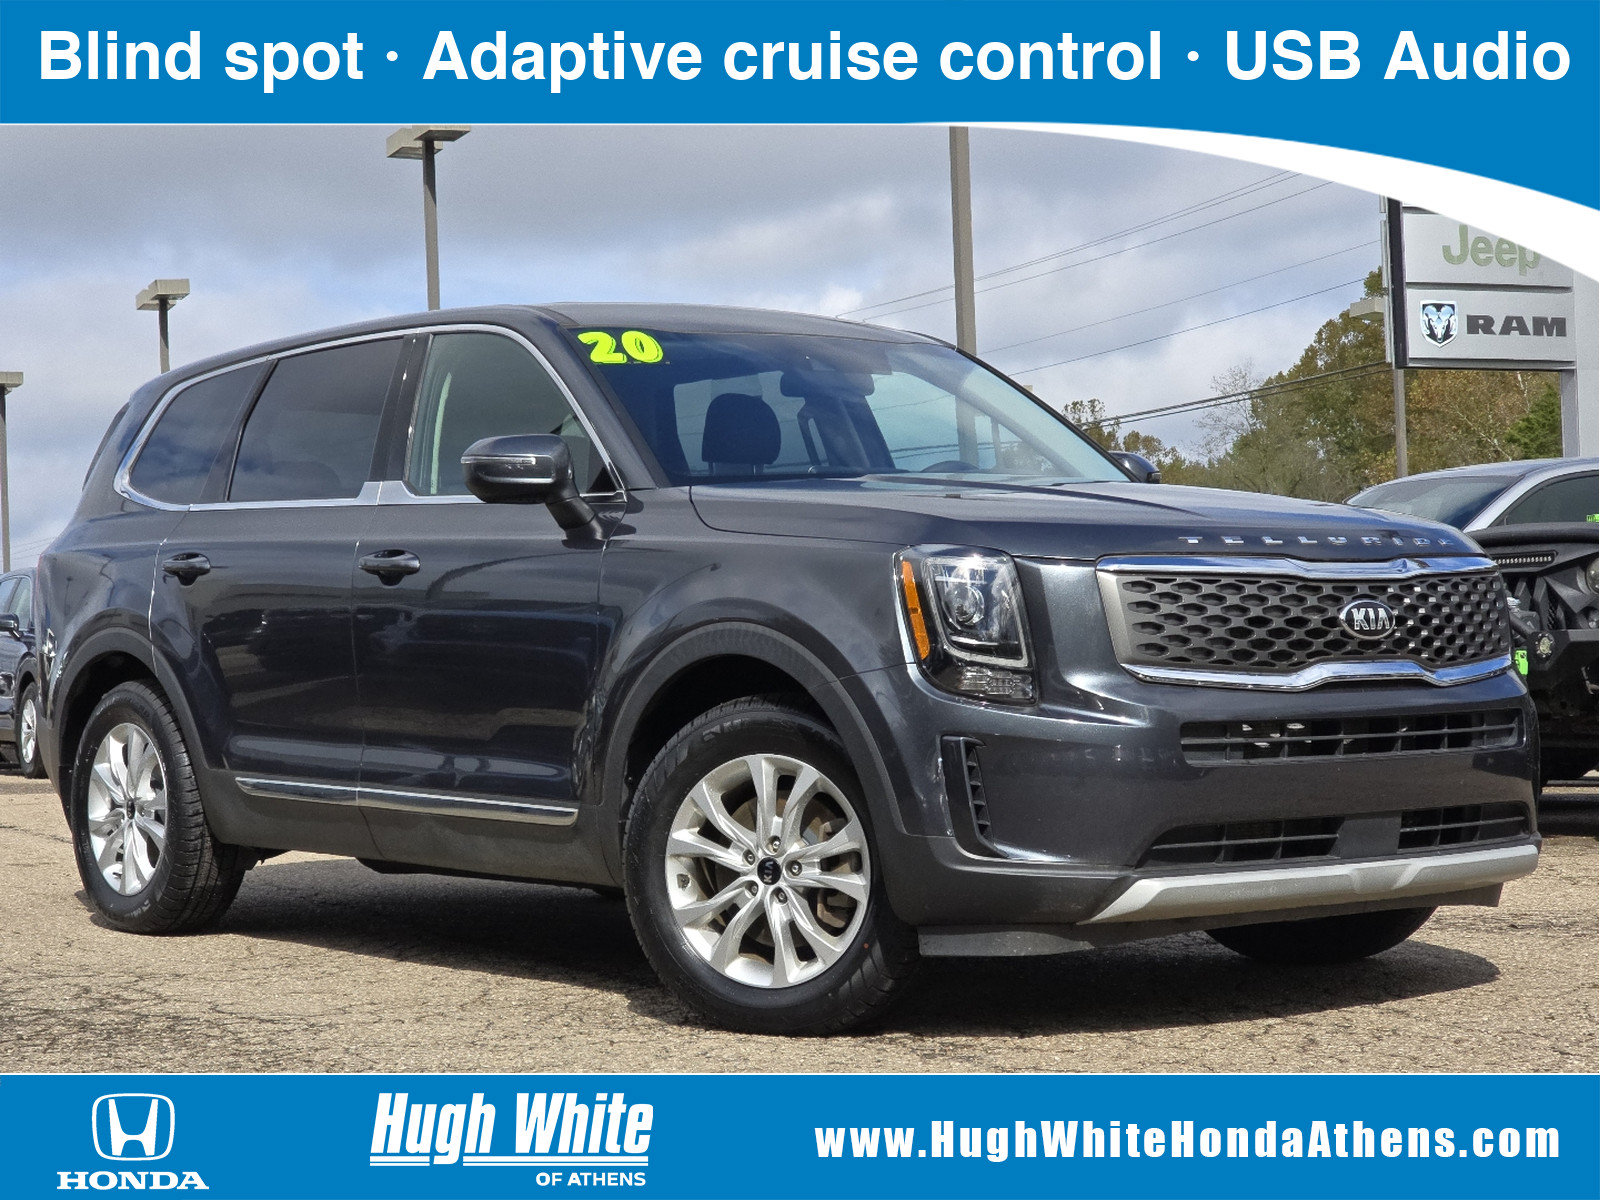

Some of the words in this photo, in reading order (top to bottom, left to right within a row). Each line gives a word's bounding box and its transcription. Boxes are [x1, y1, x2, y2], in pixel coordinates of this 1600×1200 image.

[1442, 224, 1541, 277] Jeep
[1466, 314, 1567, 337] RAM
[577, 330, 664, 364] 20
[1178, 535, 1453, 546] TELLURIDE
[1351, 607, 1390, 630] KIA
